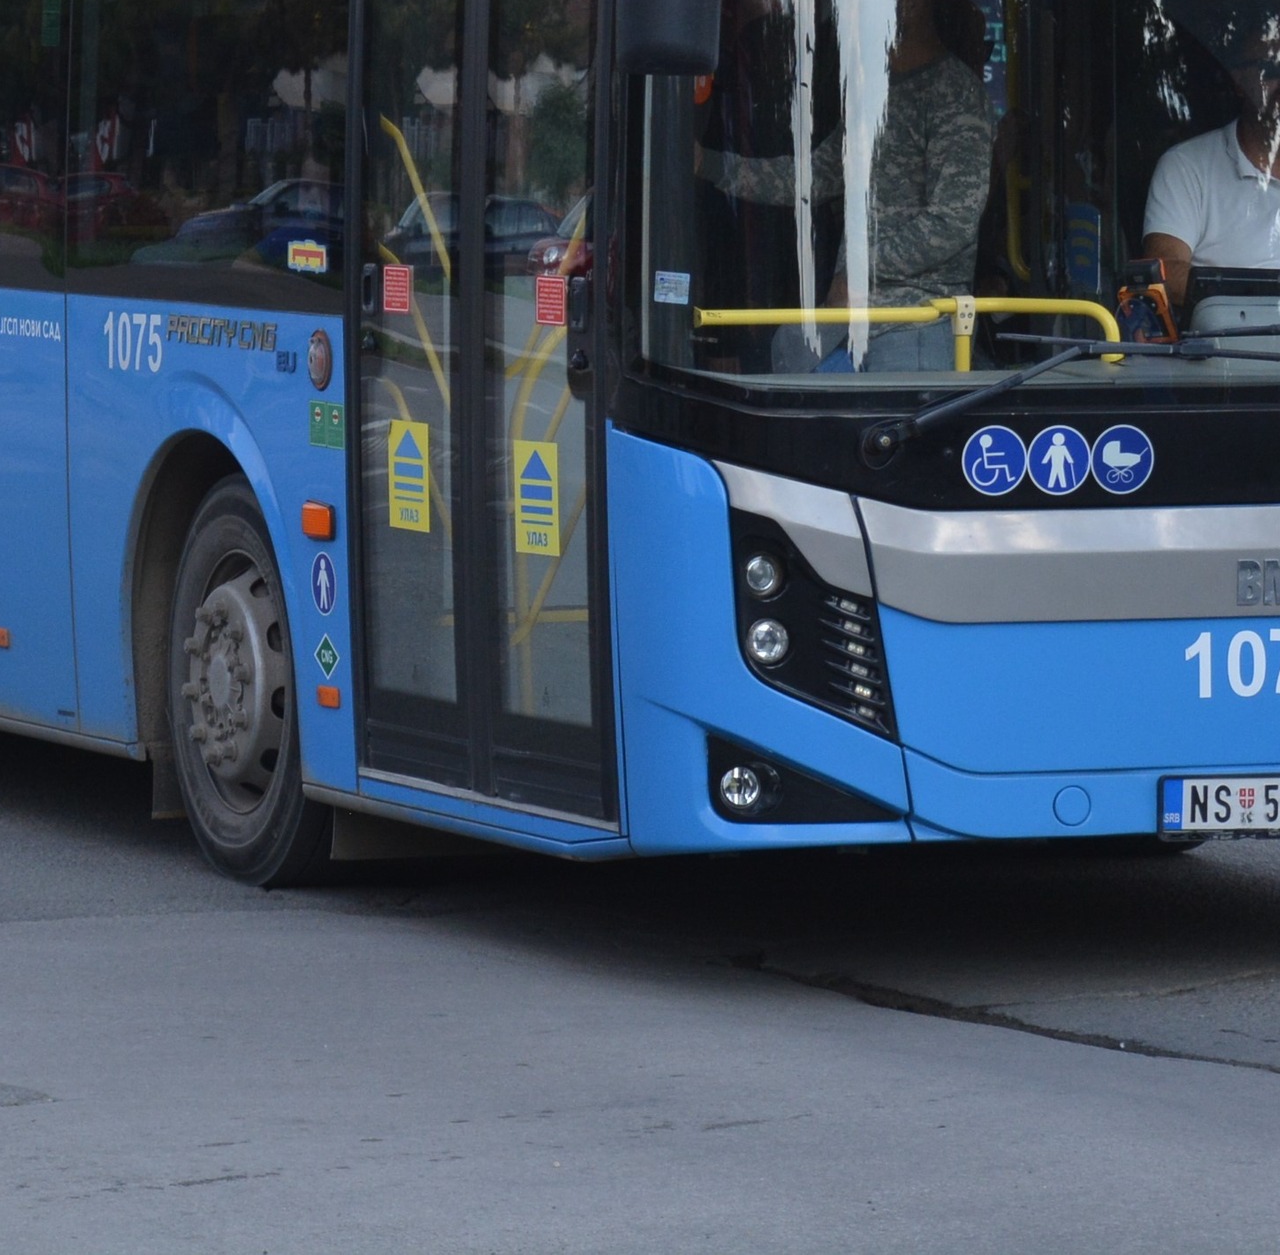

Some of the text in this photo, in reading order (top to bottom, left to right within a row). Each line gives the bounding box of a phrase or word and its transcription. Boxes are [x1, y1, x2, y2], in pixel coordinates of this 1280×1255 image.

[19, 319, 41, 337] НОВИ
[42, 320, 61, 342] САД
[103, 311, 162, 373] 1075
[238, 320, 278, 352] CNG
[399, 507, 420, 523] УЛАЗ
[526, 530, 549, 547] УЛАЗ
[1190, 784, 1232, 824] NS
[1163, 813, 1181, 824] SRB
